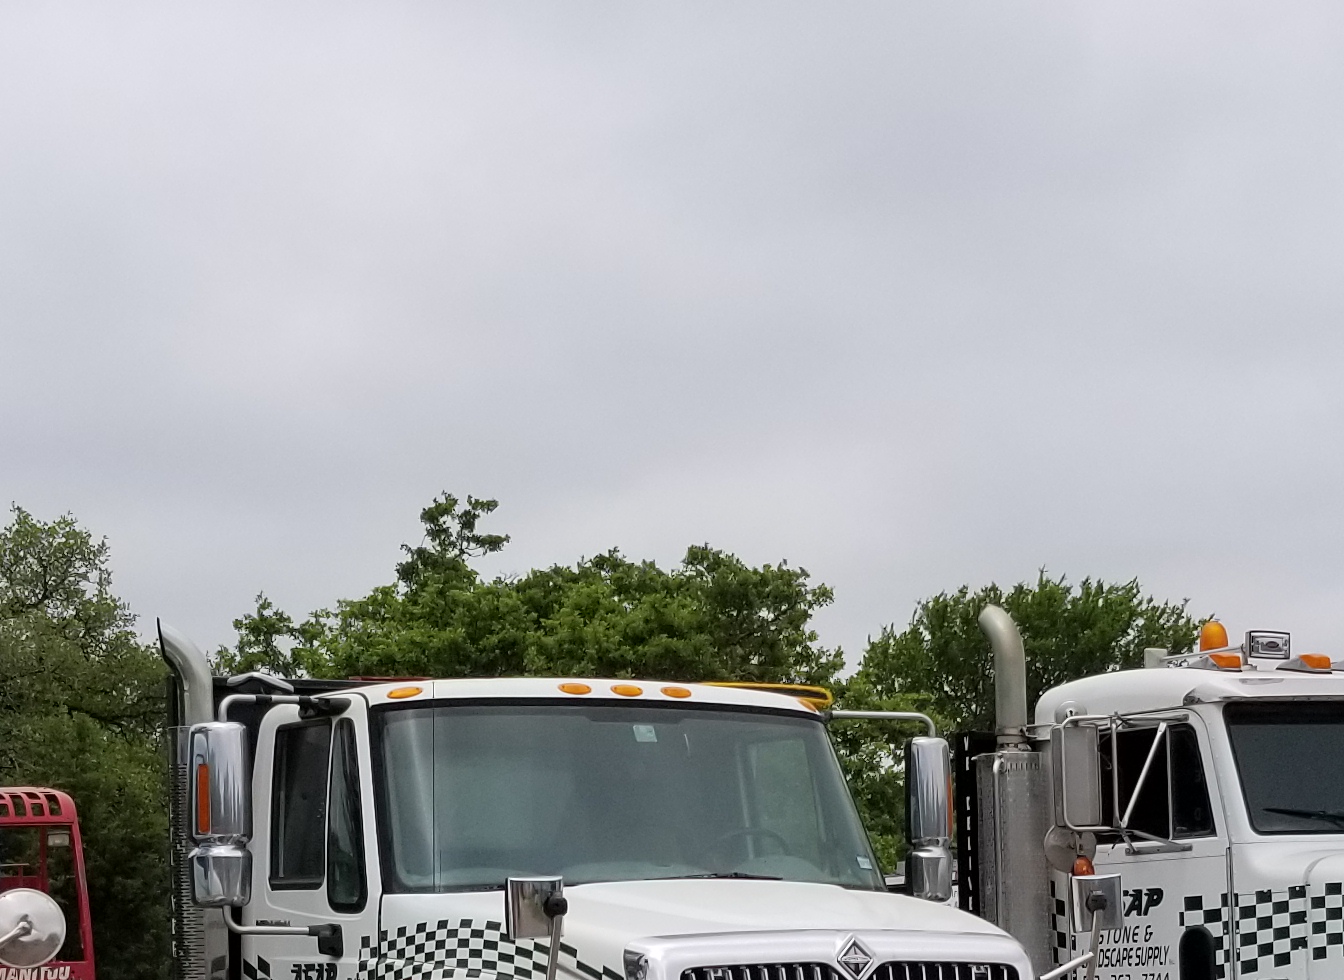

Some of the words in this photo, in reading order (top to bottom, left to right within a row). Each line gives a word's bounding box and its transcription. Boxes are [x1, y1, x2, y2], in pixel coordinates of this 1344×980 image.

[1123, 888, 1164, 917] AP
[1144, 925, 1154, 943] &
[1082, 948, 1134, 968] LDSCAPE
[1135, 945, 1170, 967] SUPPLY
